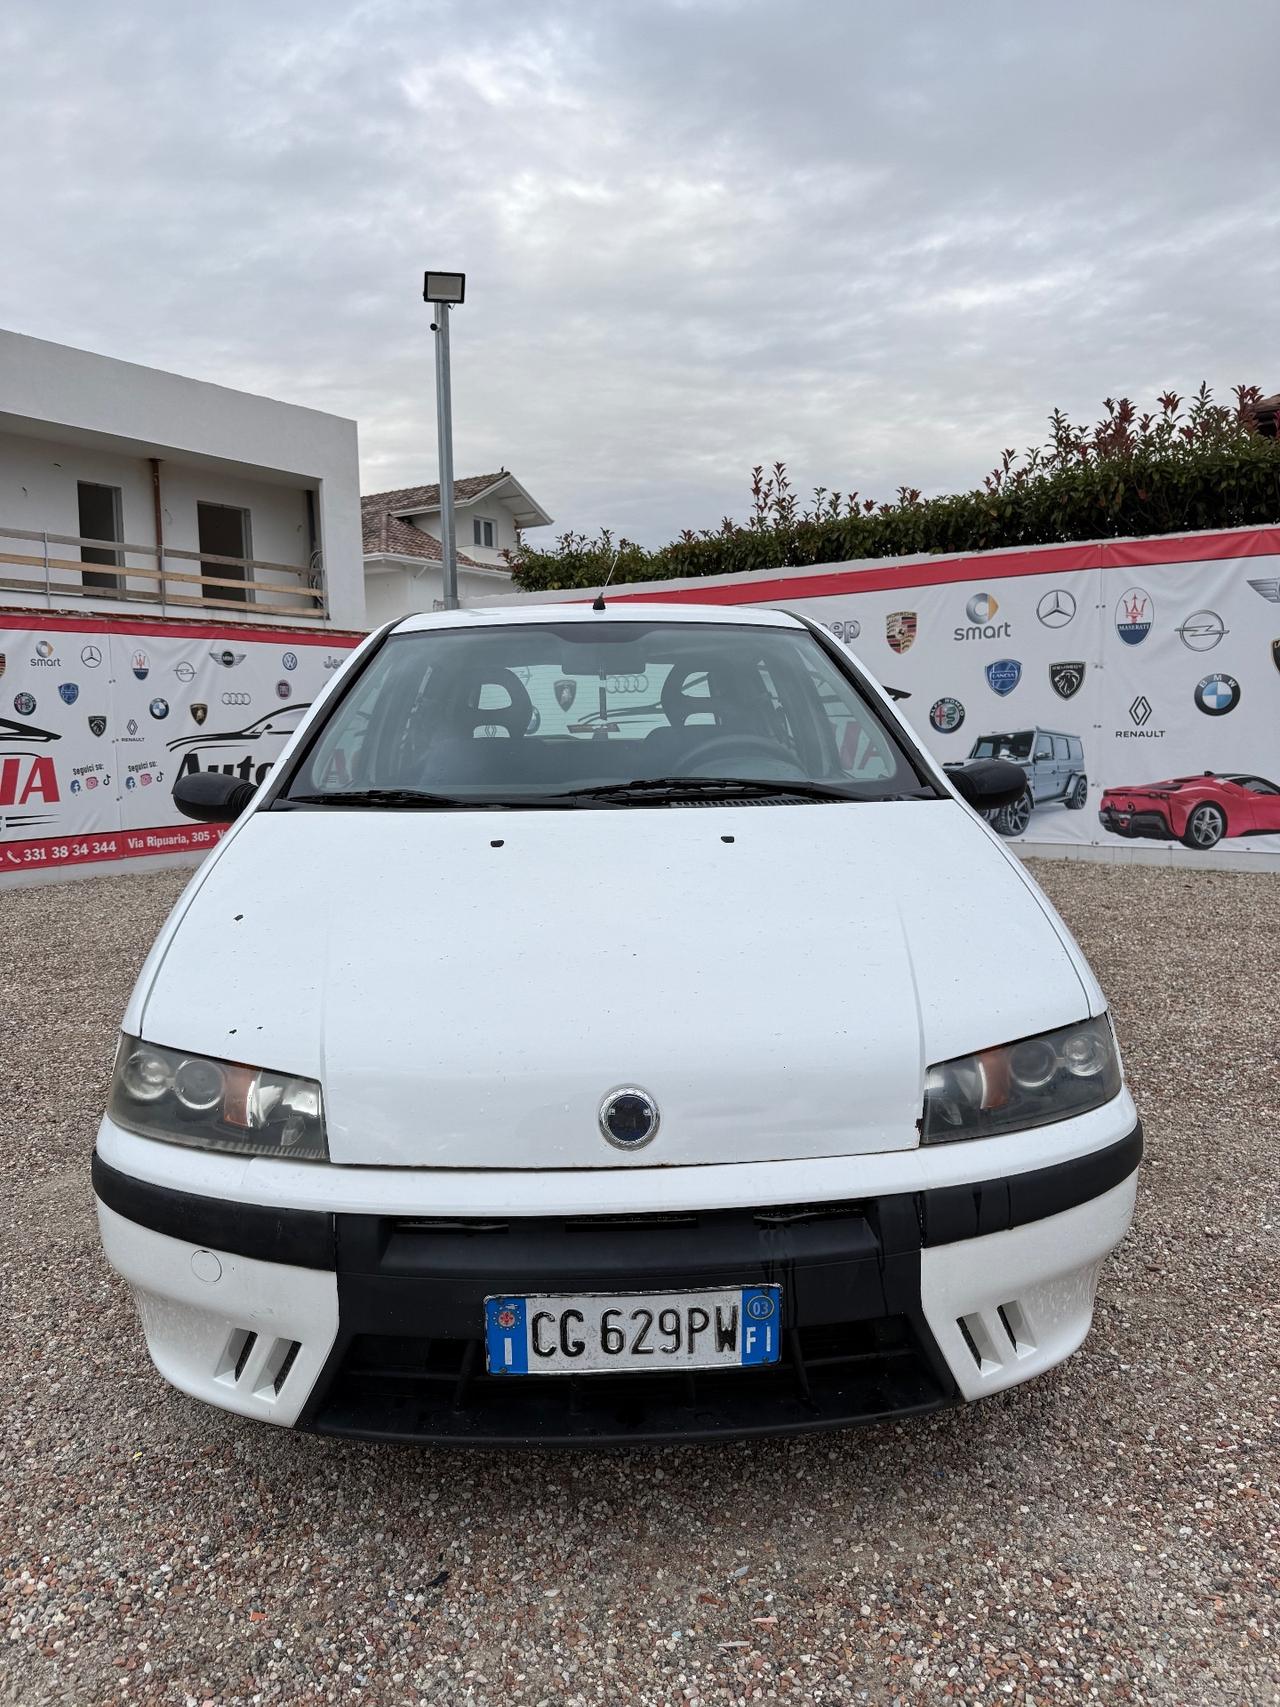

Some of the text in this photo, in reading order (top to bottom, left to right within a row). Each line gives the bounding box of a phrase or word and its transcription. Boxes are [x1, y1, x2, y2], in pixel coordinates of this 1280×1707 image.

[953, 622, 1011, 641] smart
[30, 658, 61, 667] smart
[323, 655, 344, 669] Jee
[1199, 674, 1237, 689] BMW
[1115, 730, 1166, 738] RENAULT
[72, 764, 94, 776] Seguici
[127, 761, 148, 773] Seguici
[128, 838, 144, 849] Via
[147, 834, 189, 849] Ripuaria,
[191, 831, 210, 843] 305
[23, 840, 117, 861] 331 38 34 344
[752, 1301, 770, 1315] 03
[531, 1304, 740, 1358] CG 629PW
[746, 1326, 772, 1354] FI
